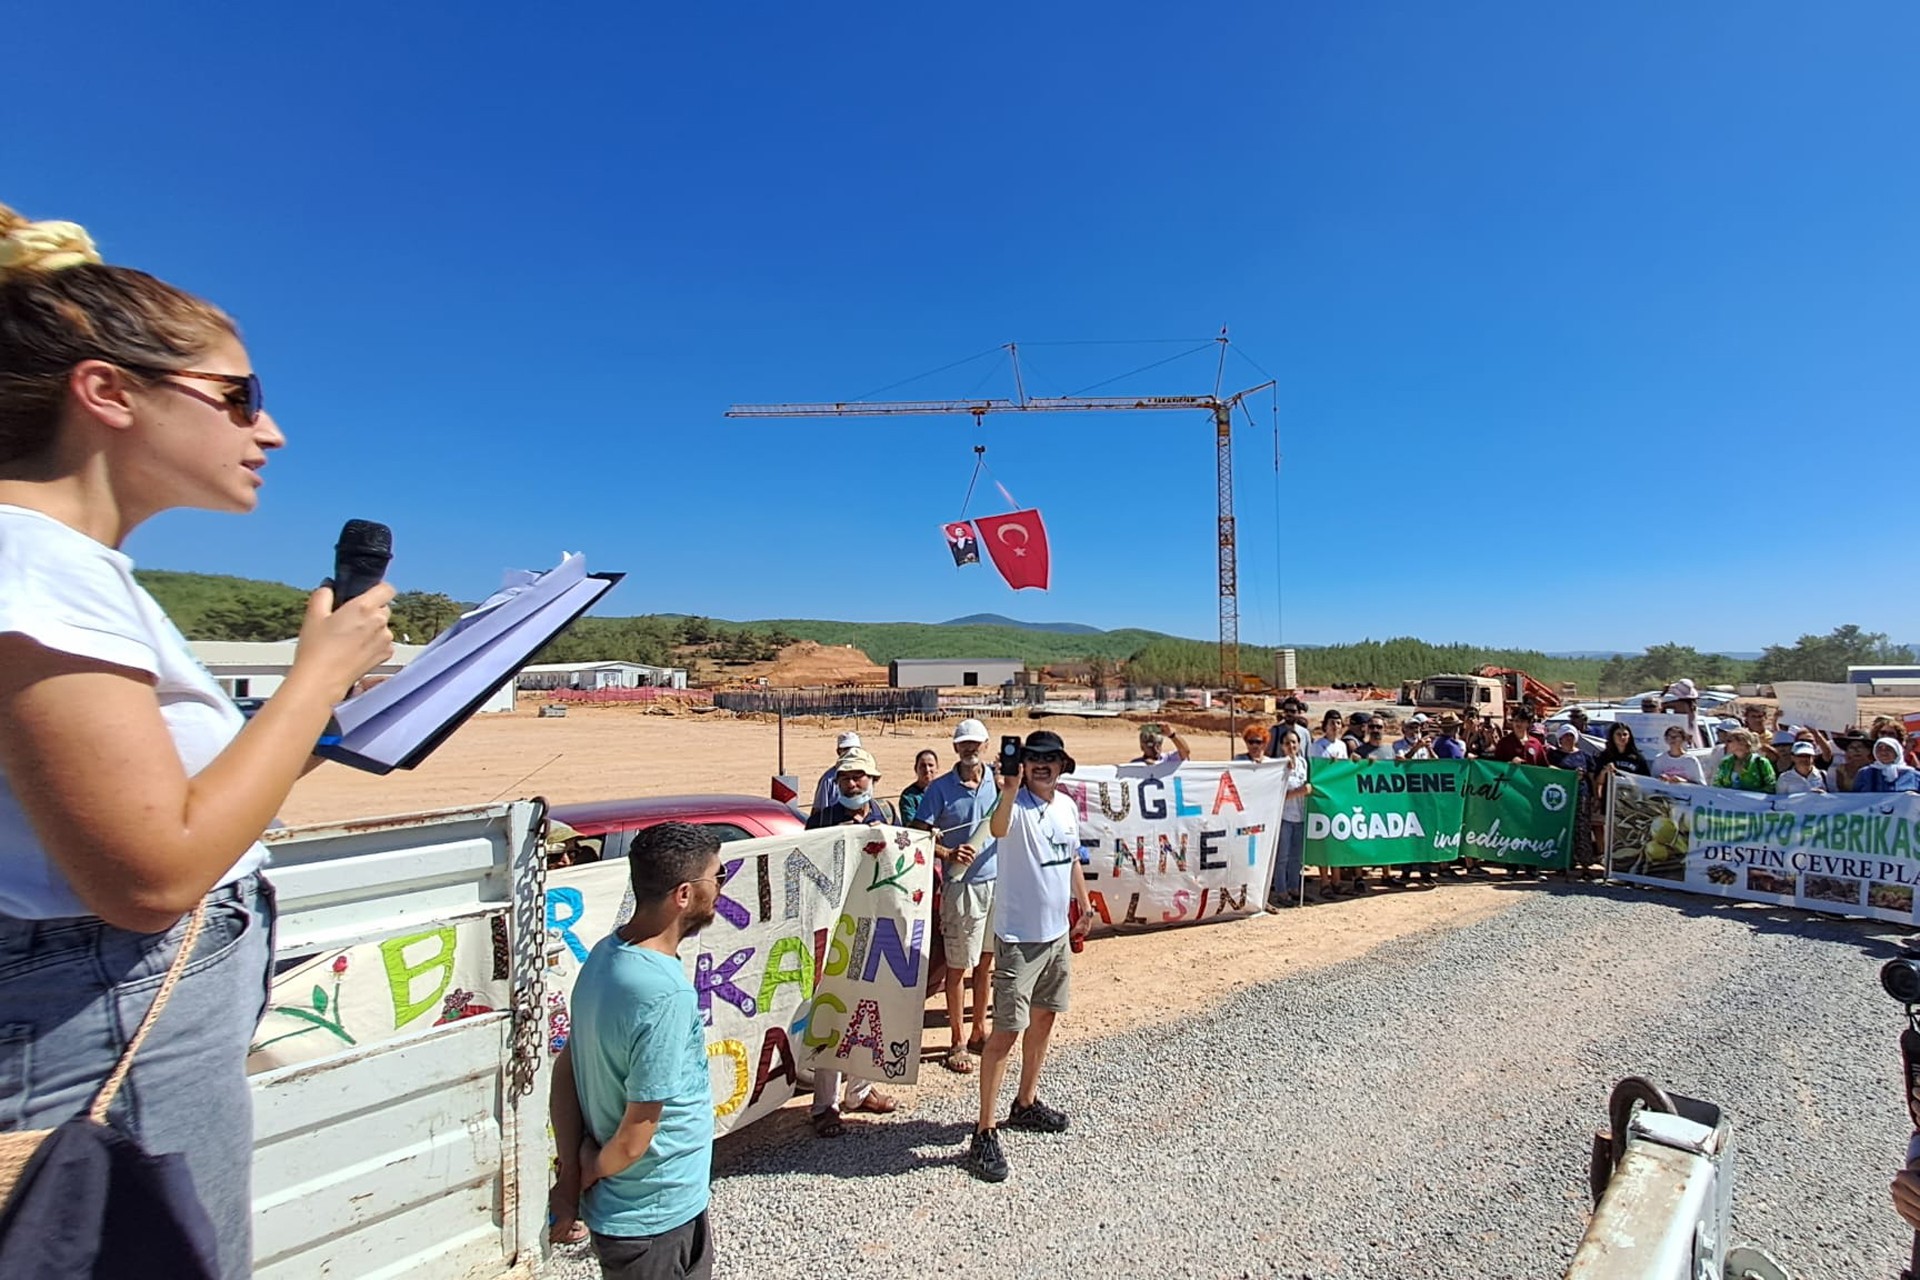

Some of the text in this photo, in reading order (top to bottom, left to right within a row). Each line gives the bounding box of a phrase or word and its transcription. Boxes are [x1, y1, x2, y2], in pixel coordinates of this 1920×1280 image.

[1356, 772, 1456, 794] MADENE
[1079, 824, 1265, 880] ENNET
[1306, 806, 1425, 841] DOĞADA
[1466, 819, 1567, 858] ediyoruz!
[1792, 853, 1873, 878] ÇEVRE
[1087, 884, 1248, 925] ALSIN
